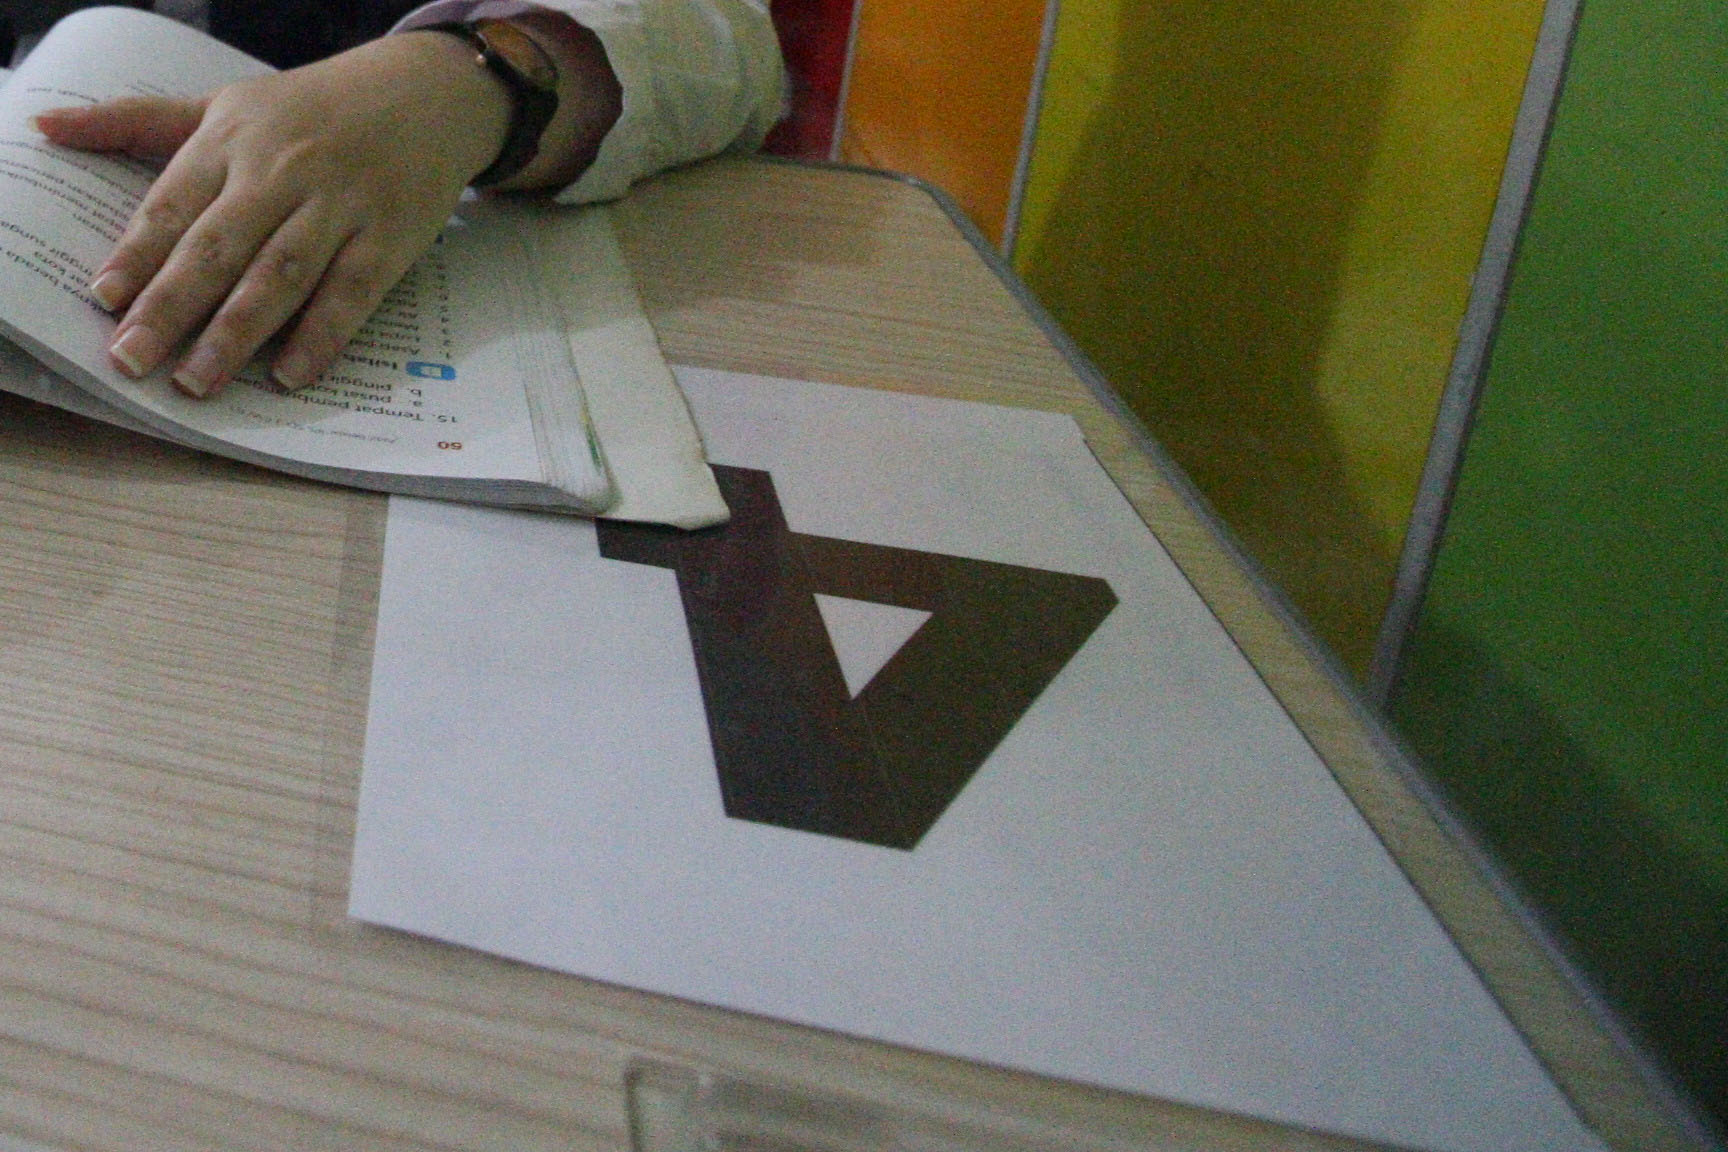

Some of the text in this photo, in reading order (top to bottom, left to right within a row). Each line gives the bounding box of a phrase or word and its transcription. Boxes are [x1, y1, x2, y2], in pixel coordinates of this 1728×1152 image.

[5, 250, 59, 287] berada
[33, 250, 67, 276] kota
[329, 373, 393, 393] pinggir
[340, 389, 393, 405] pusat
[355, 404, 426, 423] Tempat
[432, 413, 459, 424] 15.
[594, 462, 1121, 852] 4
